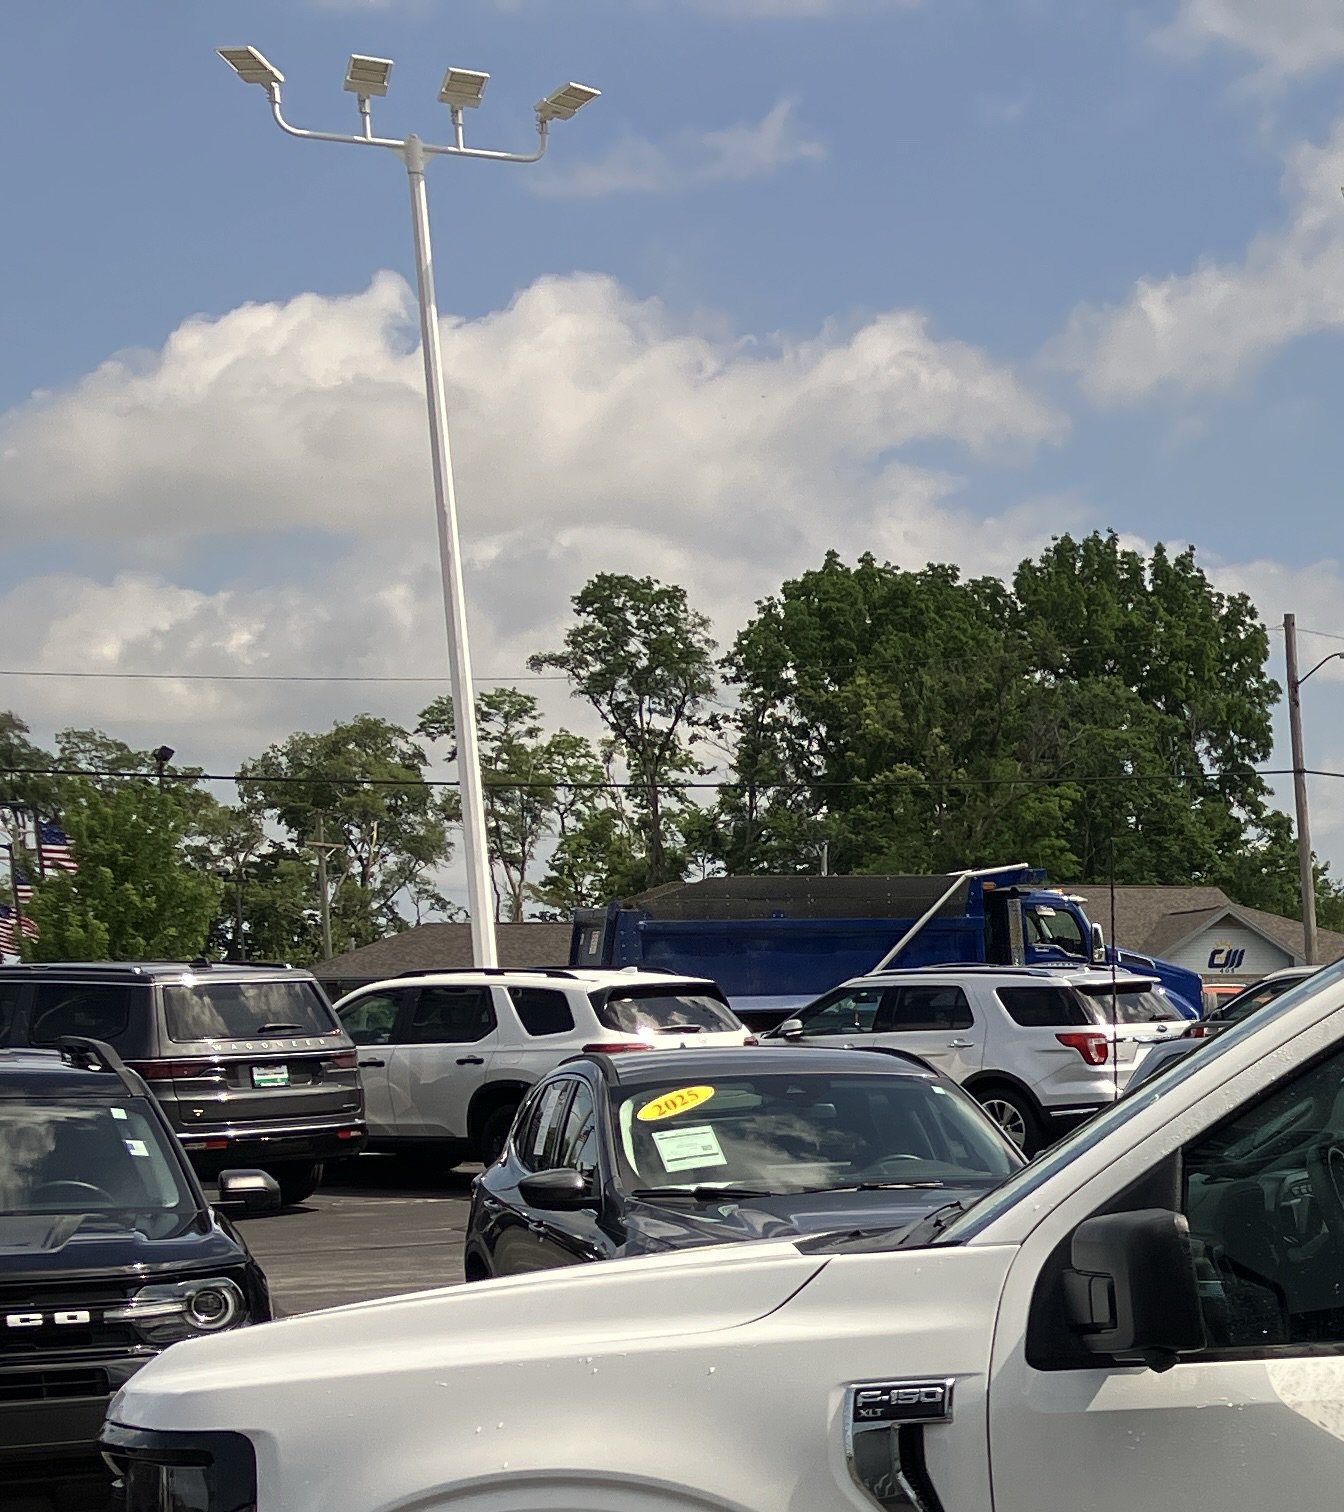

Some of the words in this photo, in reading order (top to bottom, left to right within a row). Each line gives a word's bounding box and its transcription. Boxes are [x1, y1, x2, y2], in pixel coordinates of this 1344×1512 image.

[211, 1037, 325, 1051] WAGONEER
[652, 1090, 699, 1116] 2025
[856, 1387, 945, 1407] F-150
[859, 1408, 885, 1418] XLT
